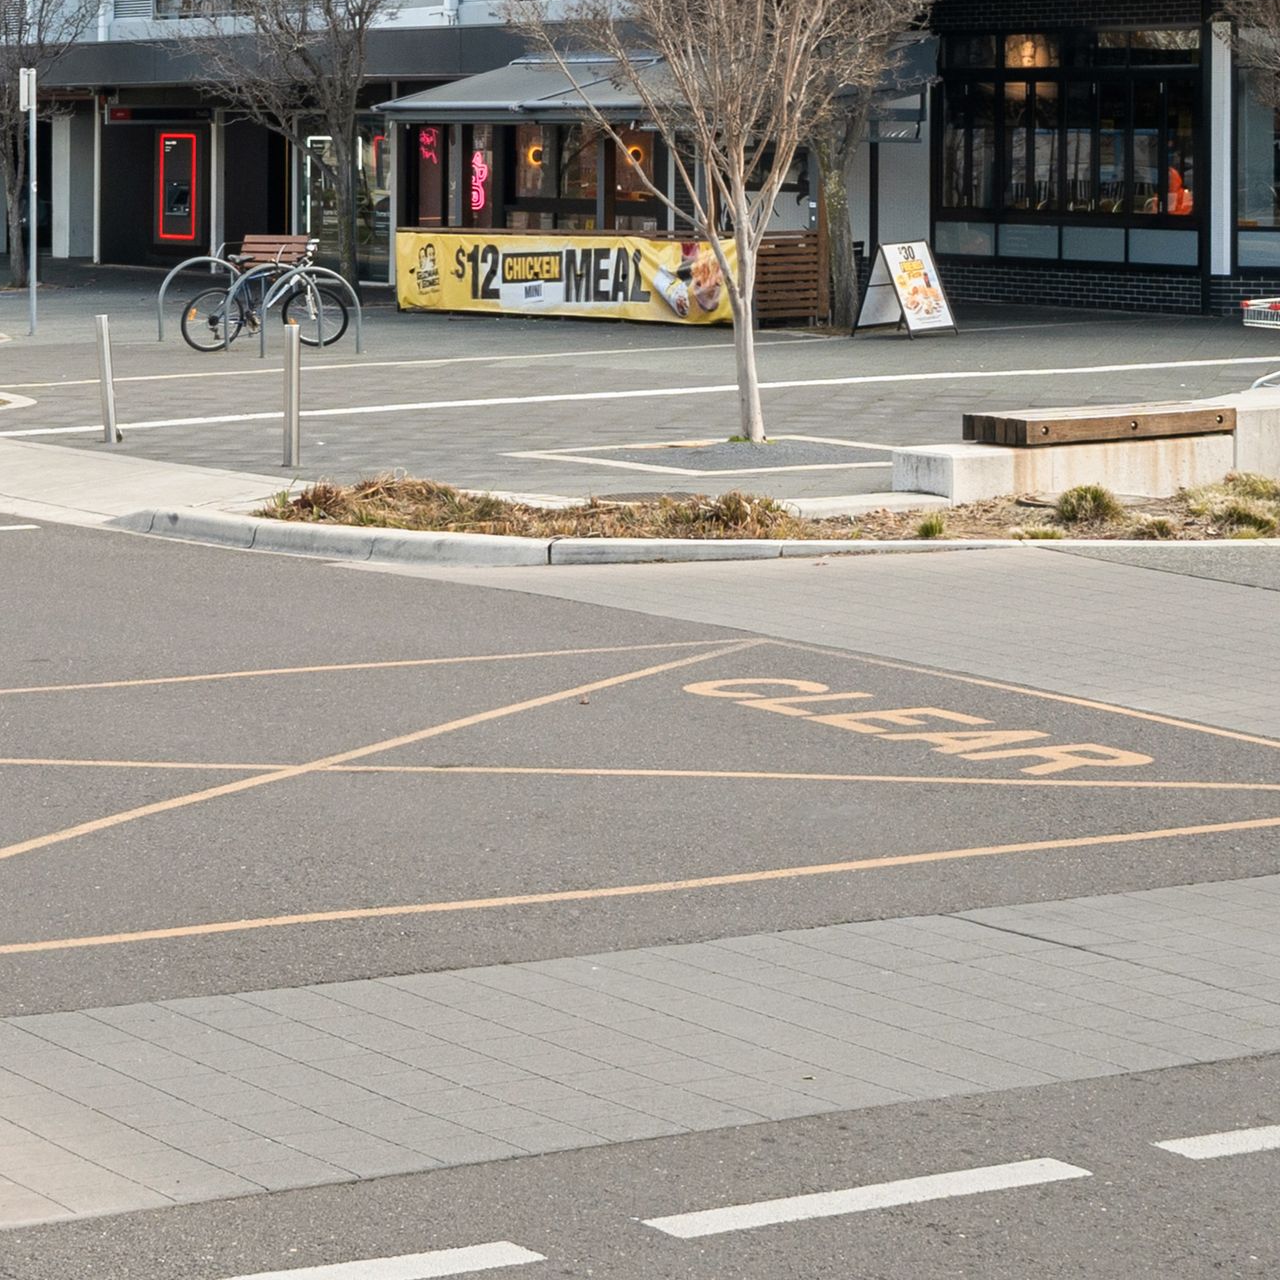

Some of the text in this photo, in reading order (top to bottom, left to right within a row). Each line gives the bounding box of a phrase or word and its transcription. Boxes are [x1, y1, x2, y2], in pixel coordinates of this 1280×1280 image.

[455, 244, 501, 300] $12
[504, 254, 560, 281] CHICKEN
[524, 283, 543, 299] MINI
[565, 247, 652, 303] MEAL
[681, 677, 1155, 776] CLEAR
